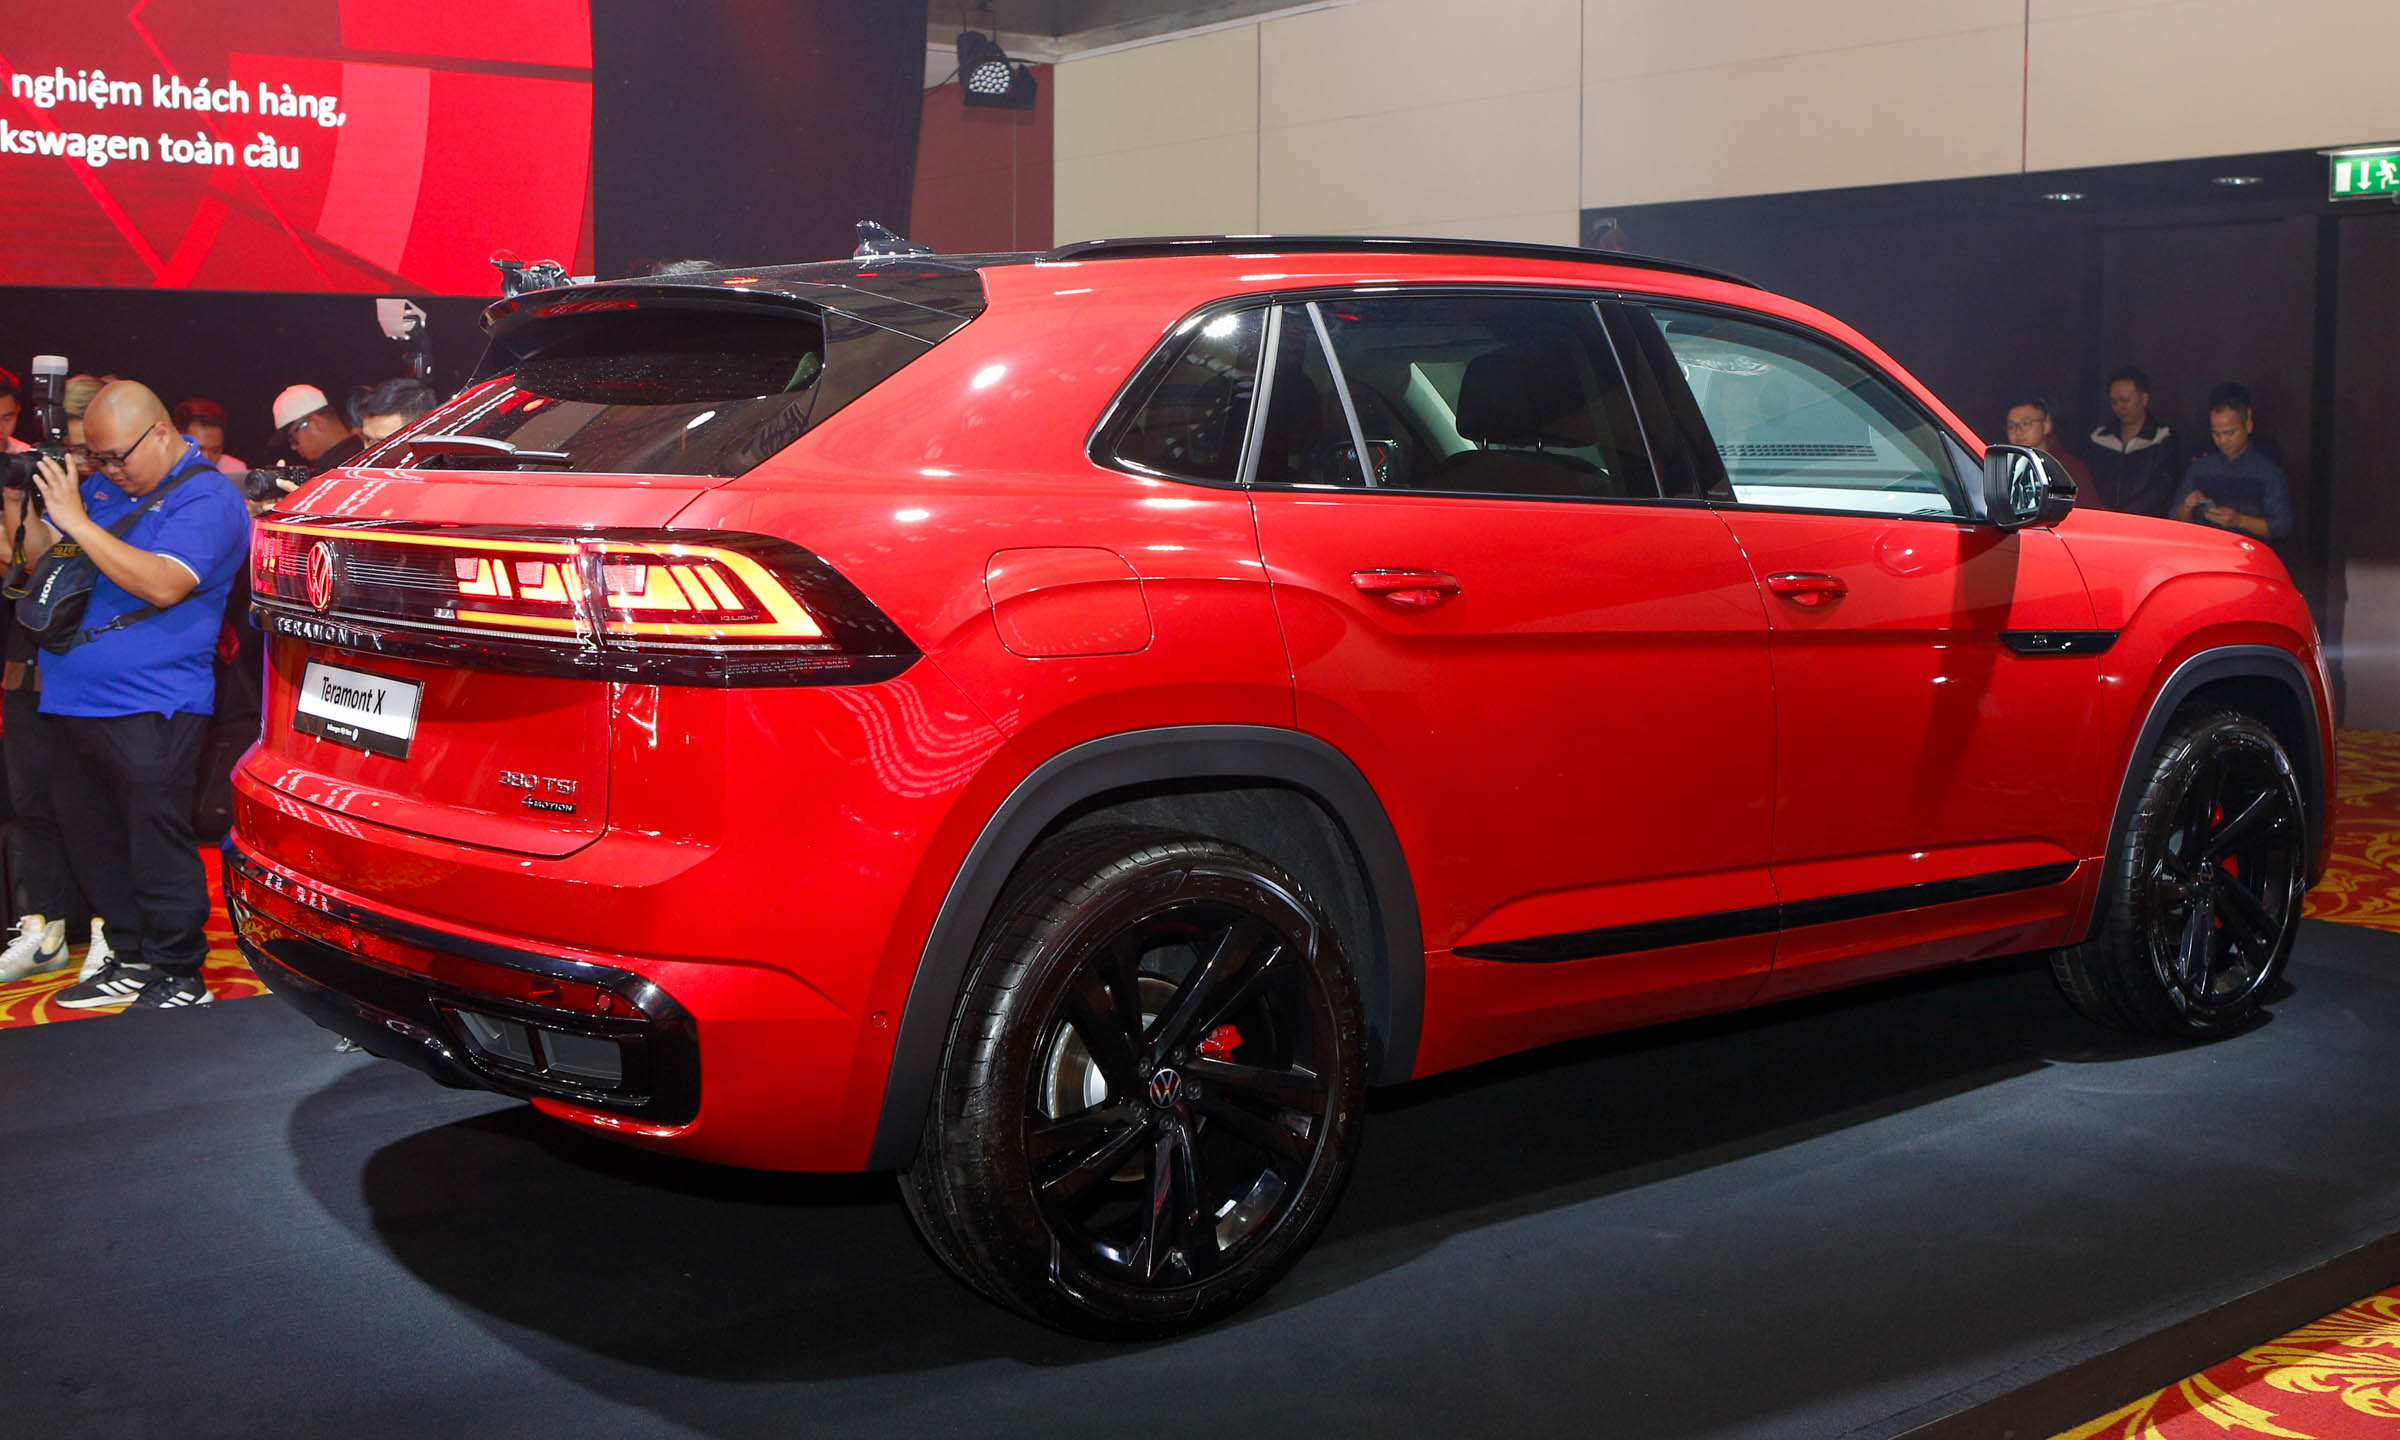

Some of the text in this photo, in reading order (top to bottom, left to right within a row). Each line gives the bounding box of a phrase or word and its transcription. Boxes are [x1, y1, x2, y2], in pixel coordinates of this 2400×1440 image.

[11, 66, 347, 128] nghiệm khách hàng,
[0, 118, 300, 170] kswagen toàn cầu
[277, 617, 382, 651] TERAMONT X
[321, 676, 386, 715] Teramont X
[498, 769, 578, 795] 380 TSI
